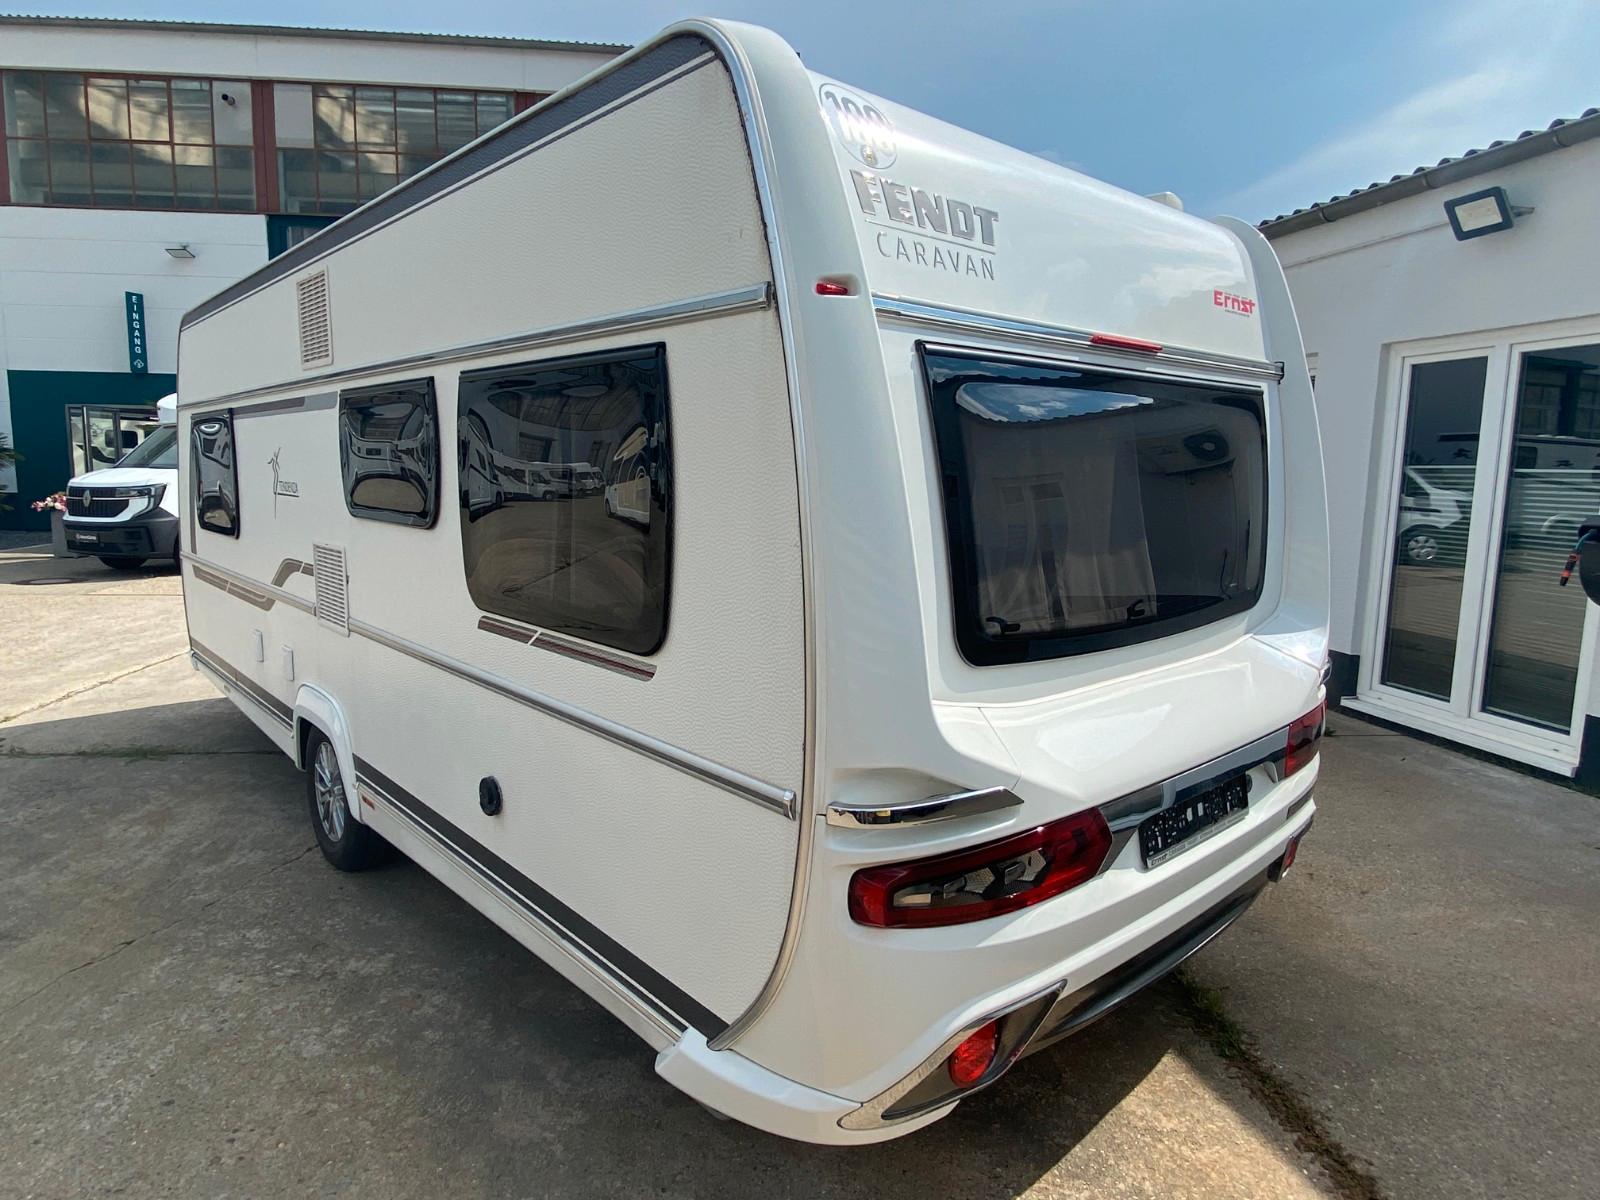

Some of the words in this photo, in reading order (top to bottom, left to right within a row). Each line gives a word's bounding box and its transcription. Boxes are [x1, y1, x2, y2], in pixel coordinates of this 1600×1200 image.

[850, 169, 999, 247] FENDT
[876, 231, 995, 281] CARAVAN
[131, 295, 142, 354] EINGANG
[1213, 289, 1256, 314] Ernst
